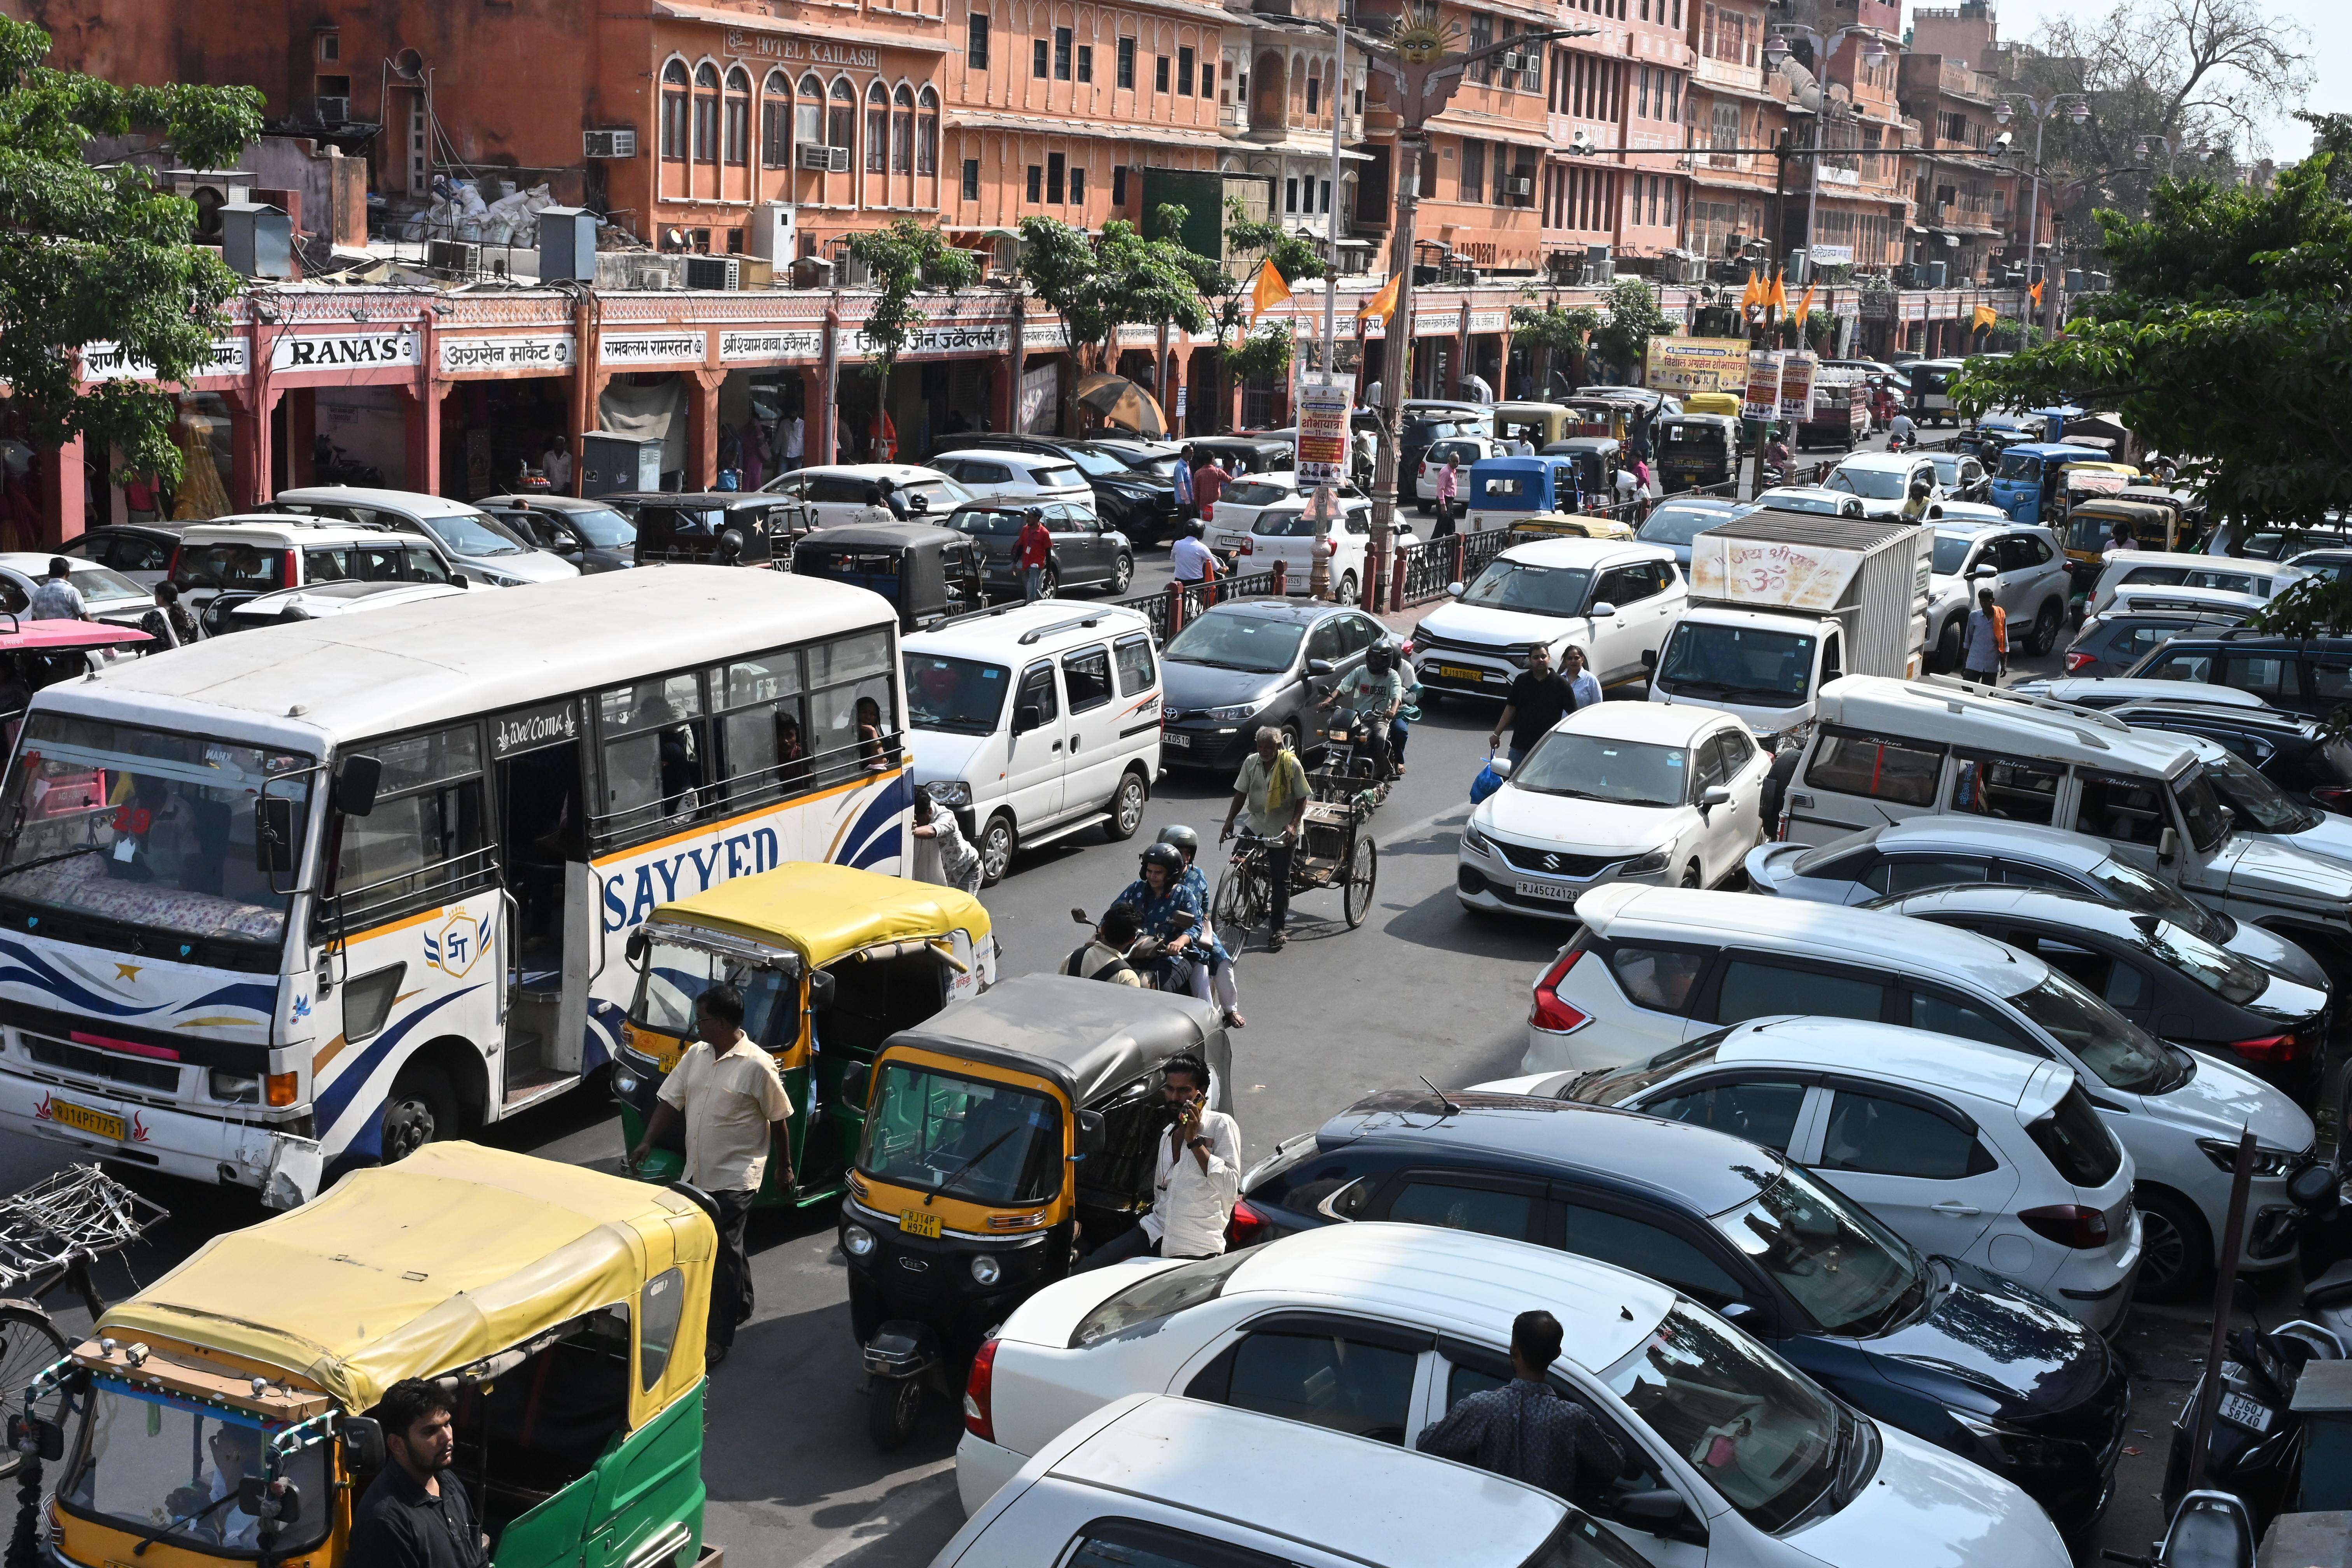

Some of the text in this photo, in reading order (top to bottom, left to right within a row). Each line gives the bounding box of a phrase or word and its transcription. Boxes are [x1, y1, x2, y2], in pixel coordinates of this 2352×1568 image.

[756, 37, 877, 68] HOTEL KAILASH
[762, 338, 781, 352] बाबा
[783, 331, 812, 352] ज्वैलर्स
[939, 327, 996, 350] ज्वैलर्स
[290, 337, 397, 365] RANA'S
[445, 340, 506, 366] अग्रसेन
[509, 340, 550, 362] मार्केट
[605, 341, 649, 357] रामबल्लभ
[650, 339, 693, 357] रामरतन
[1664, 355, 1687, 367] विशाल
[1688, 357, 1712, 369] अग्रसेन
[1712, 358, 1746, 371] शोभायात्रा
[1750, 373, 1777, 382] शोभायात्रा
[1302, 416, 1344, 430] शोभायात्रा
[1731, 548, 1766, 564] जय
[1869, 737, 1902, 746] Bolero
[1995, 760, 2029, 769] Bolero
[2105, 778, 2140, 788] Bolero
[112, 805, 151, 834] 29
[604, 828, 778, 934] SAYYED
[1522, 883, 1577, 900] RJ45CZ4129
[57, 1105, 121, 1136] RJ14PF7751
[908, 1211, 934, 1226] RJ14P
[907, 1222, 933, 1237] H9741
[2232, 1396, 2264, 1417] RJ60J
[2227, 1406, 2259, 1427] S8740
